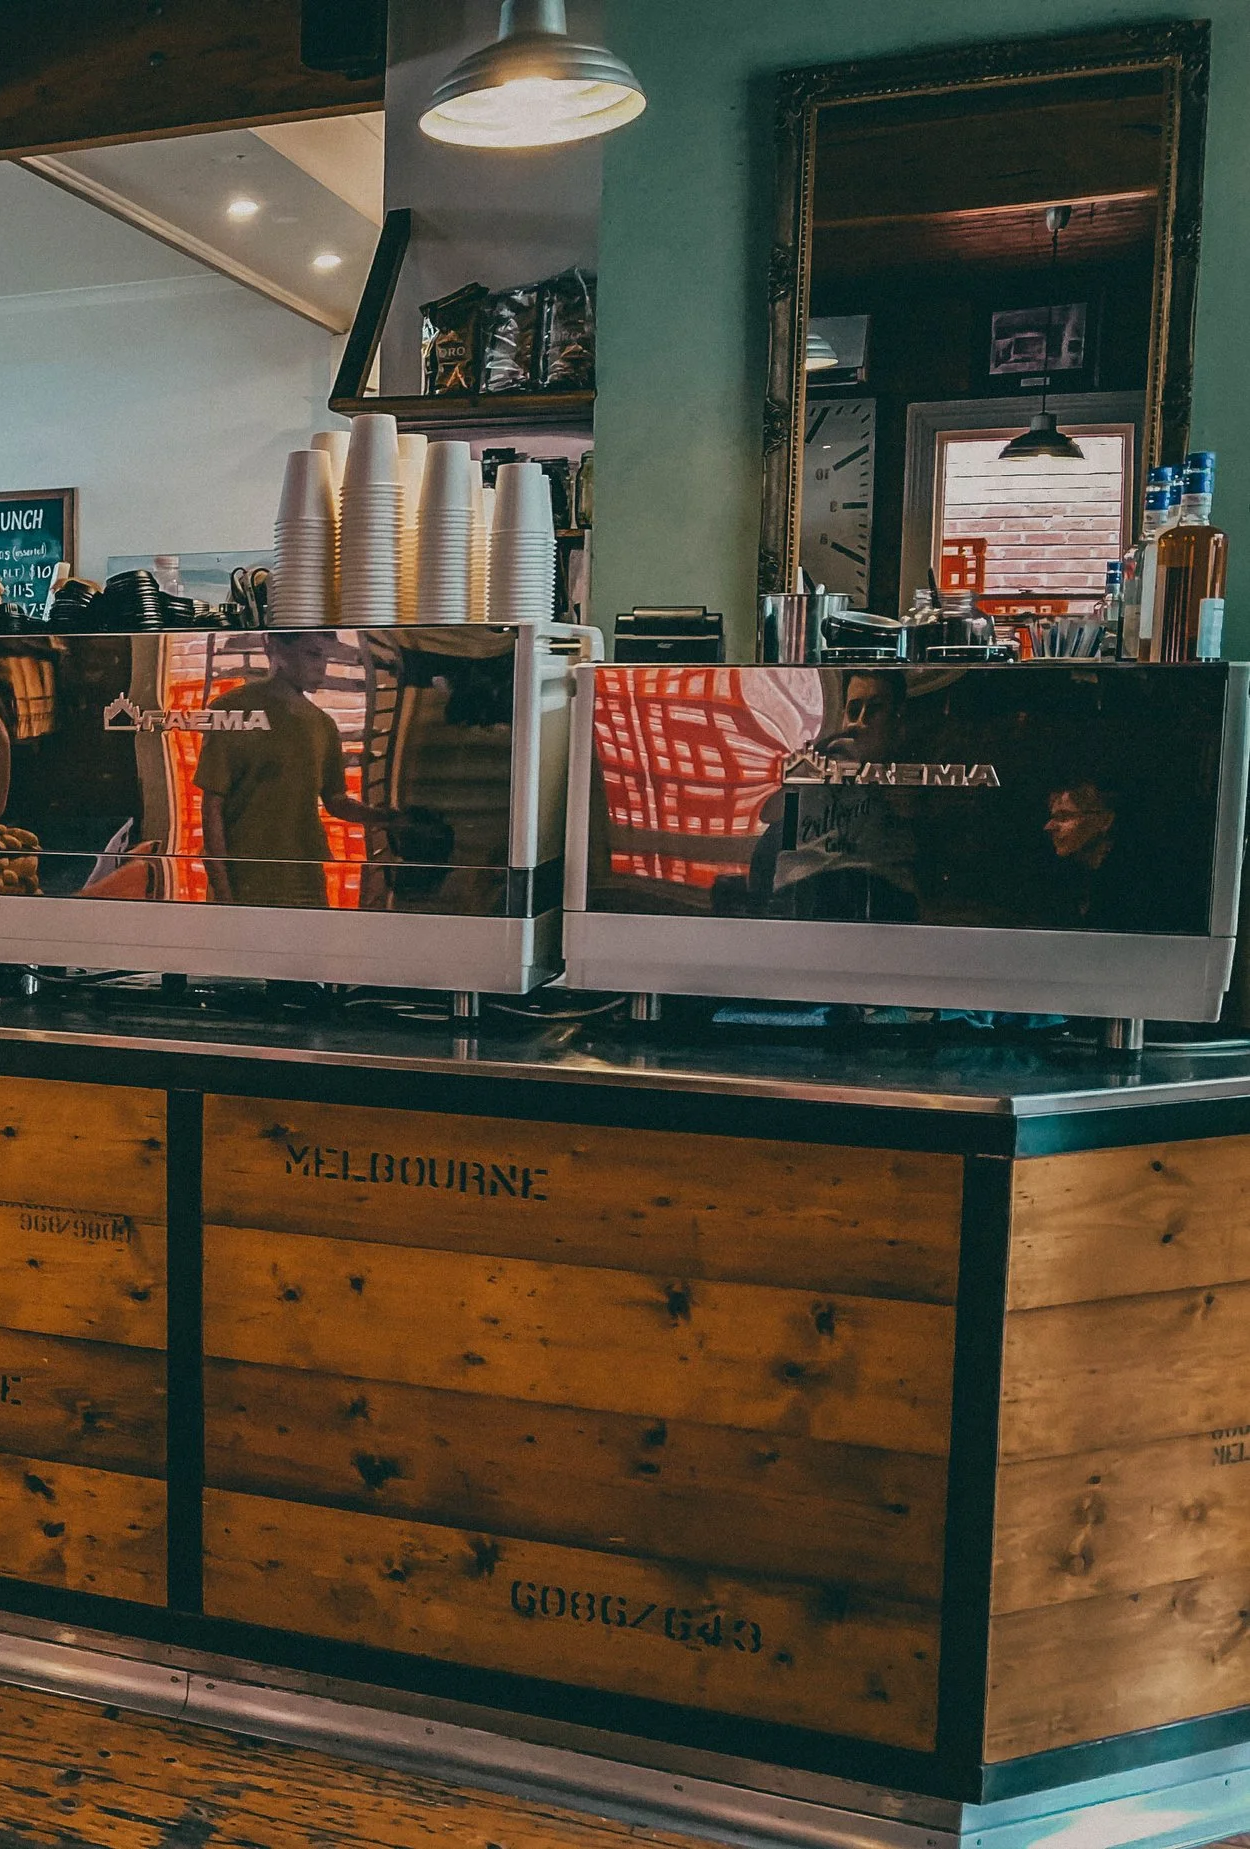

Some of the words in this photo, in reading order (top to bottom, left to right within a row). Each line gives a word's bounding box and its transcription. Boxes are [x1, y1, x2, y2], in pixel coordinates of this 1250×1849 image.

[141, 709, 272, 732] FAEMA
[830, 761, 1001, 787] FAEMA
[285, 1143, 549, 1201] MELBOURNE
